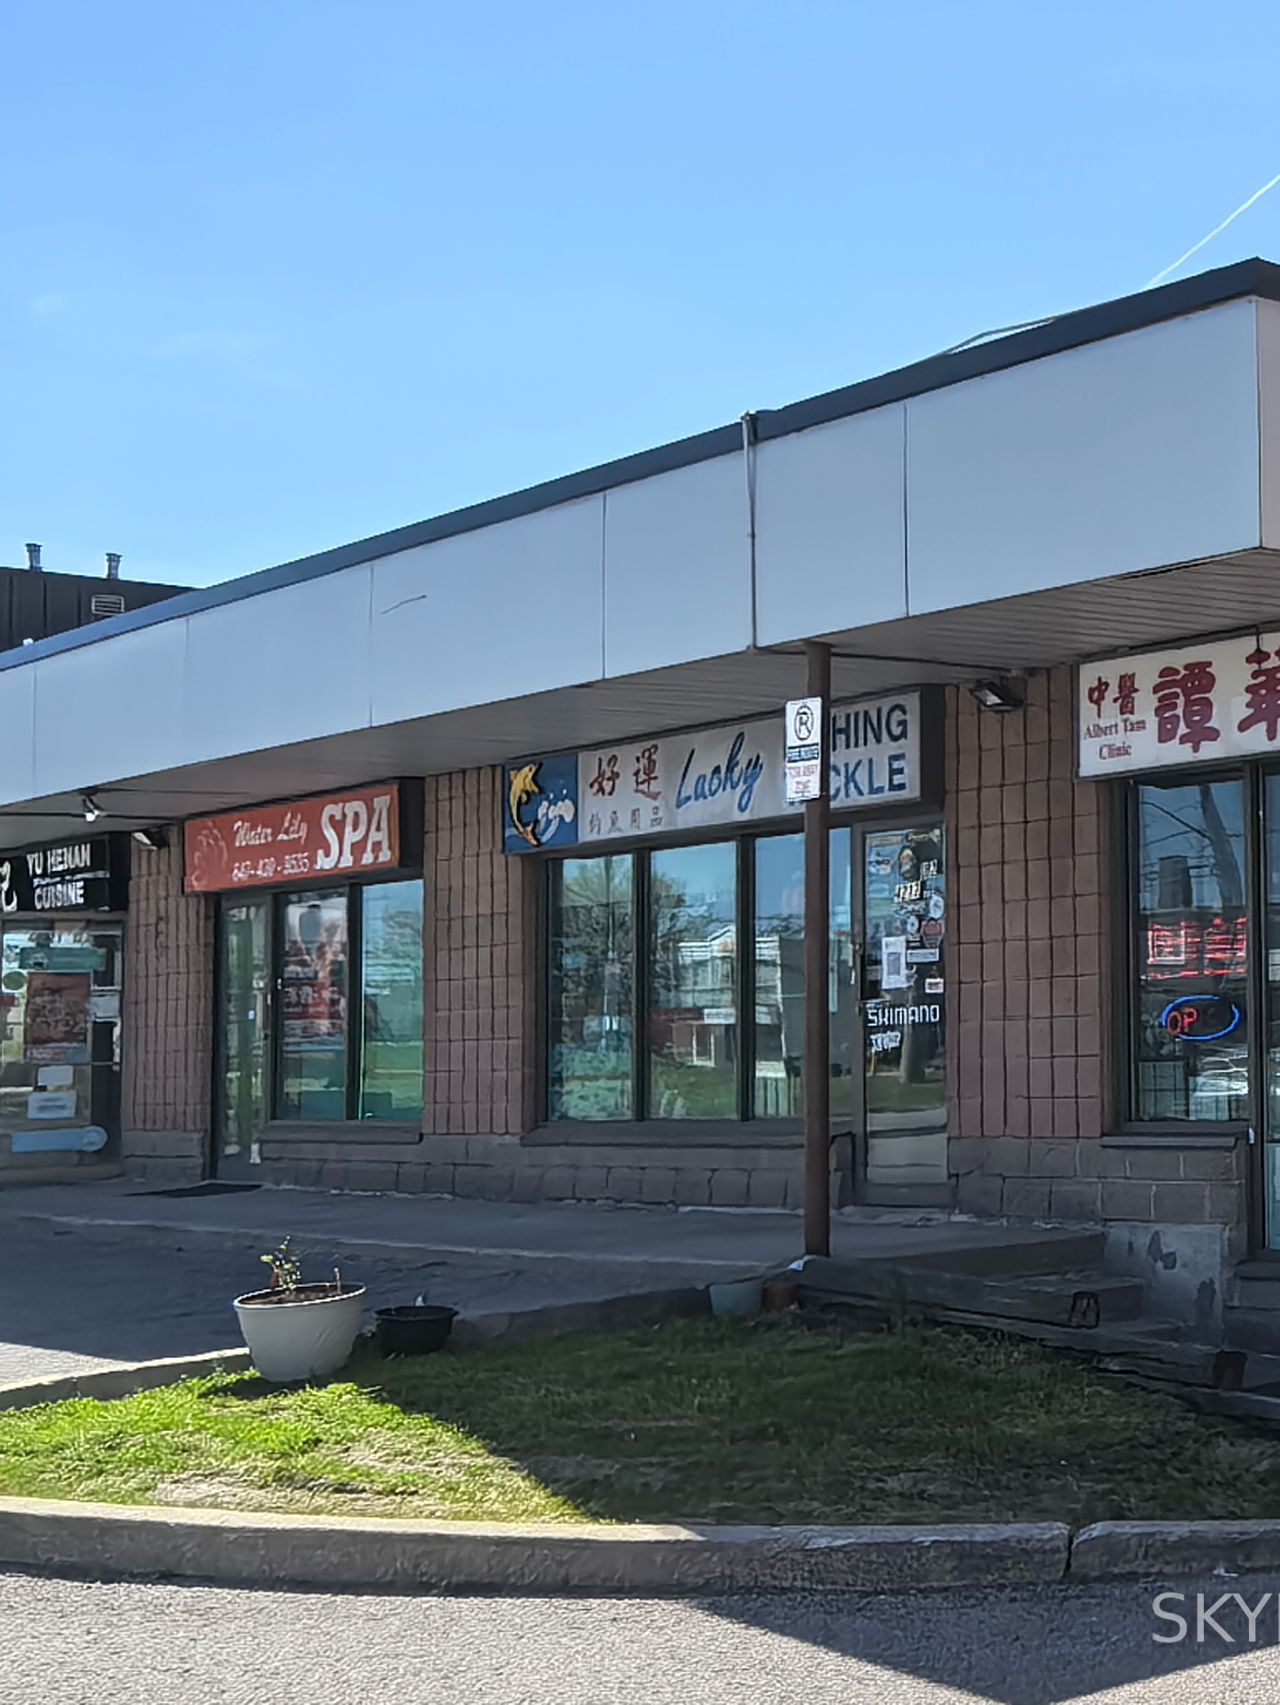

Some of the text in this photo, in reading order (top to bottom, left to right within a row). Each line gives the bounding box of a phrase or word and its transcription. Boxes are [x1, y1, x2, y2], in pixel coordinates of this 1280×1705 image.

[831, 703, 908, 752] HING
[1084, 718, 1147, 740] Albert Tam
[1099, 741, 1132, 760] Clinic
[589, 744, 662, 801] 好運
[831, 752, 907, 801] CKLE
[277, 811, 308, 844] Lily
[314, 795, 392, 870] SPA
[34, 881, 84, 910] CUISINE
[867, 1005, 940, 1027] SHIMANO
